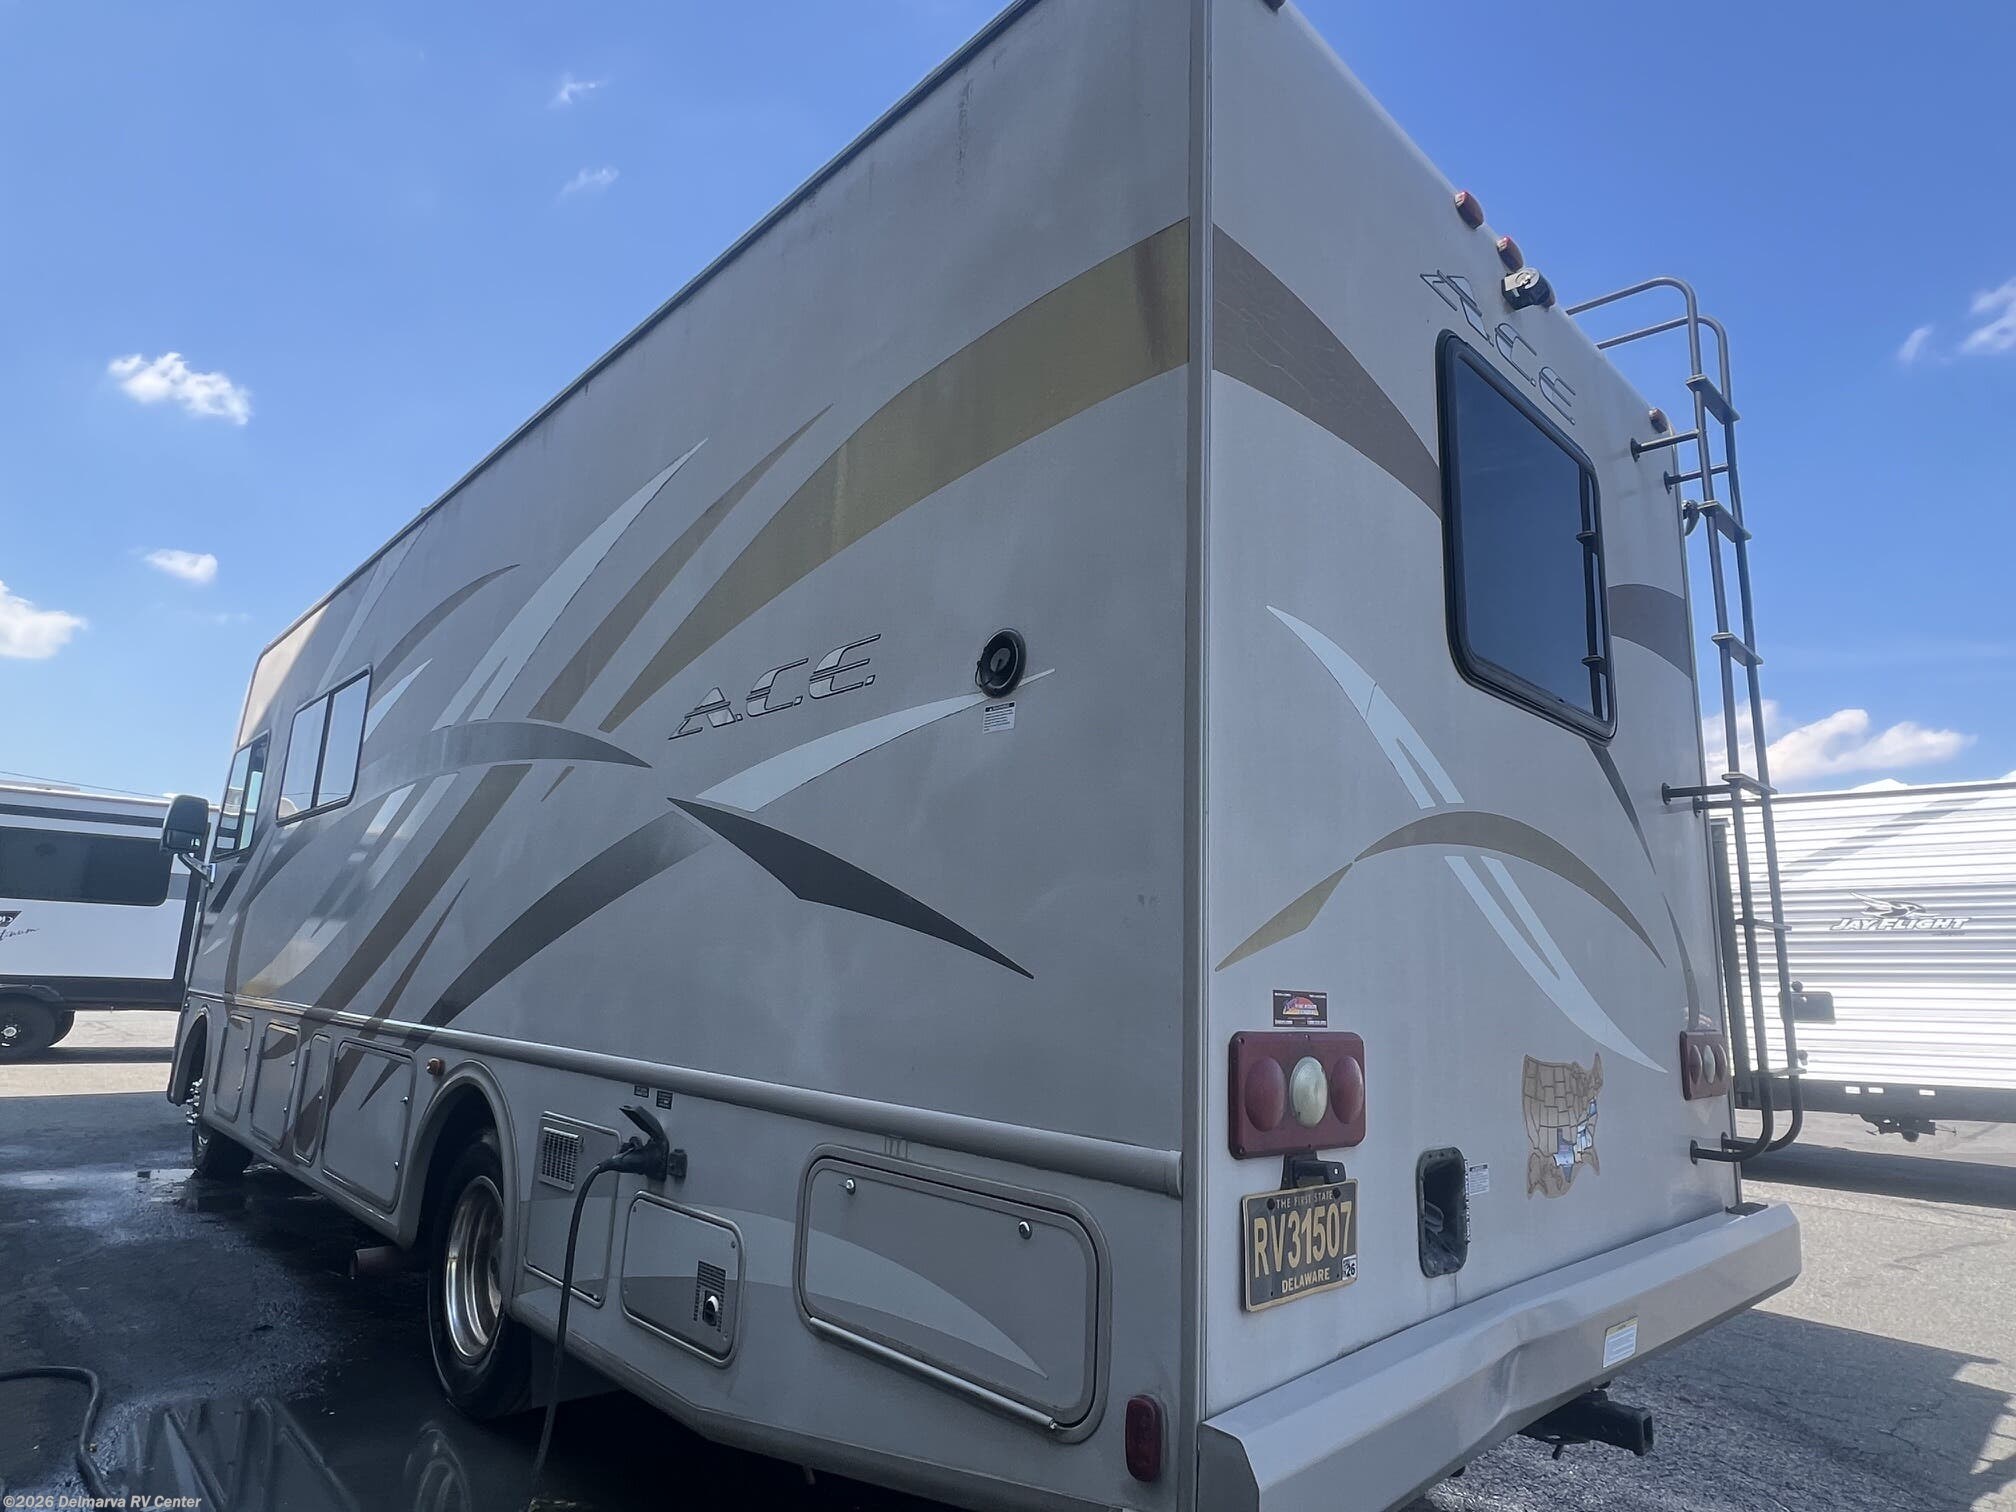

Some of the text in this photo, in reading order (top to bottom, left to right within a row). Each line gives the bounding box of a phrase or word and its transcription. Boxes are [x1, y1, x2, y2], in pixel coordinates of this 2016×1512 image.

[668, 633, 882, 741] A.C.E.
[1829, 918, 1972, 930] JAY FLIGHT
[1276, 1197, 1291, 1209] THE
[1314, 1189, 1334, 1203] STATE
[1253, 1200, 1352, 1278] RV31507
[1281, 1267, 1330, 1294] DELAWARE
